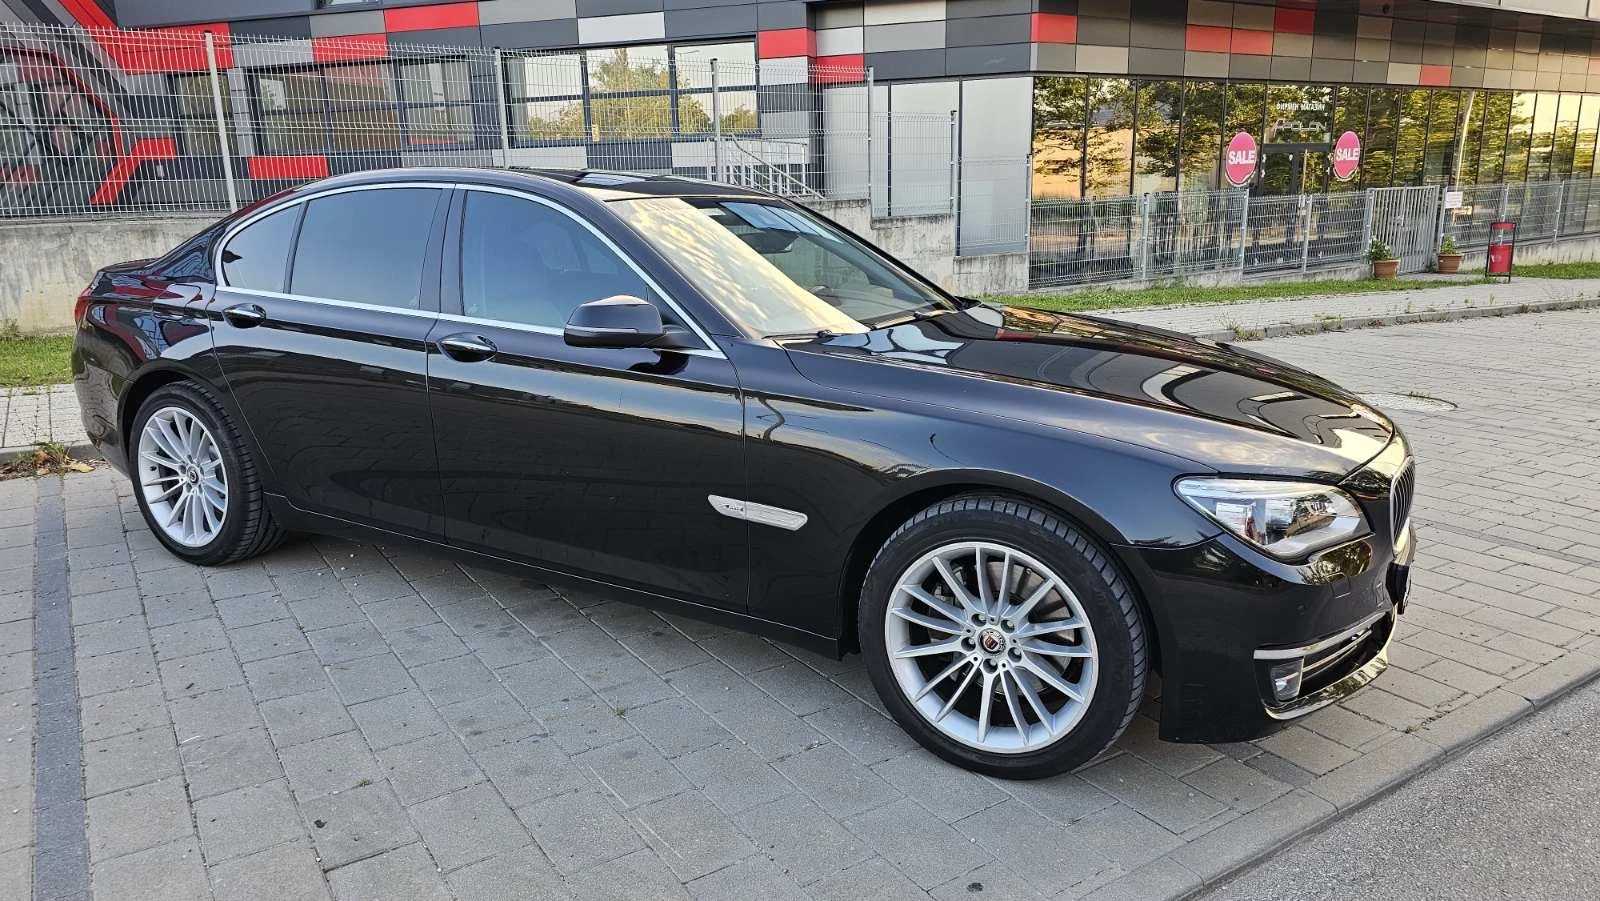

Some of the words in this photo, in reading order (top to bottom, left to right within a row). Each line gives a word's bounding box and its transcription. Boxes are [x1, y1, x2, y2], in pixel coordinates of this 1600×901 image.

[1300, 102, 1326, 111] МАГАЗИН
[1228, 150, 1256, 165] SALE
[1336, 148, 1360, 161] SALE
